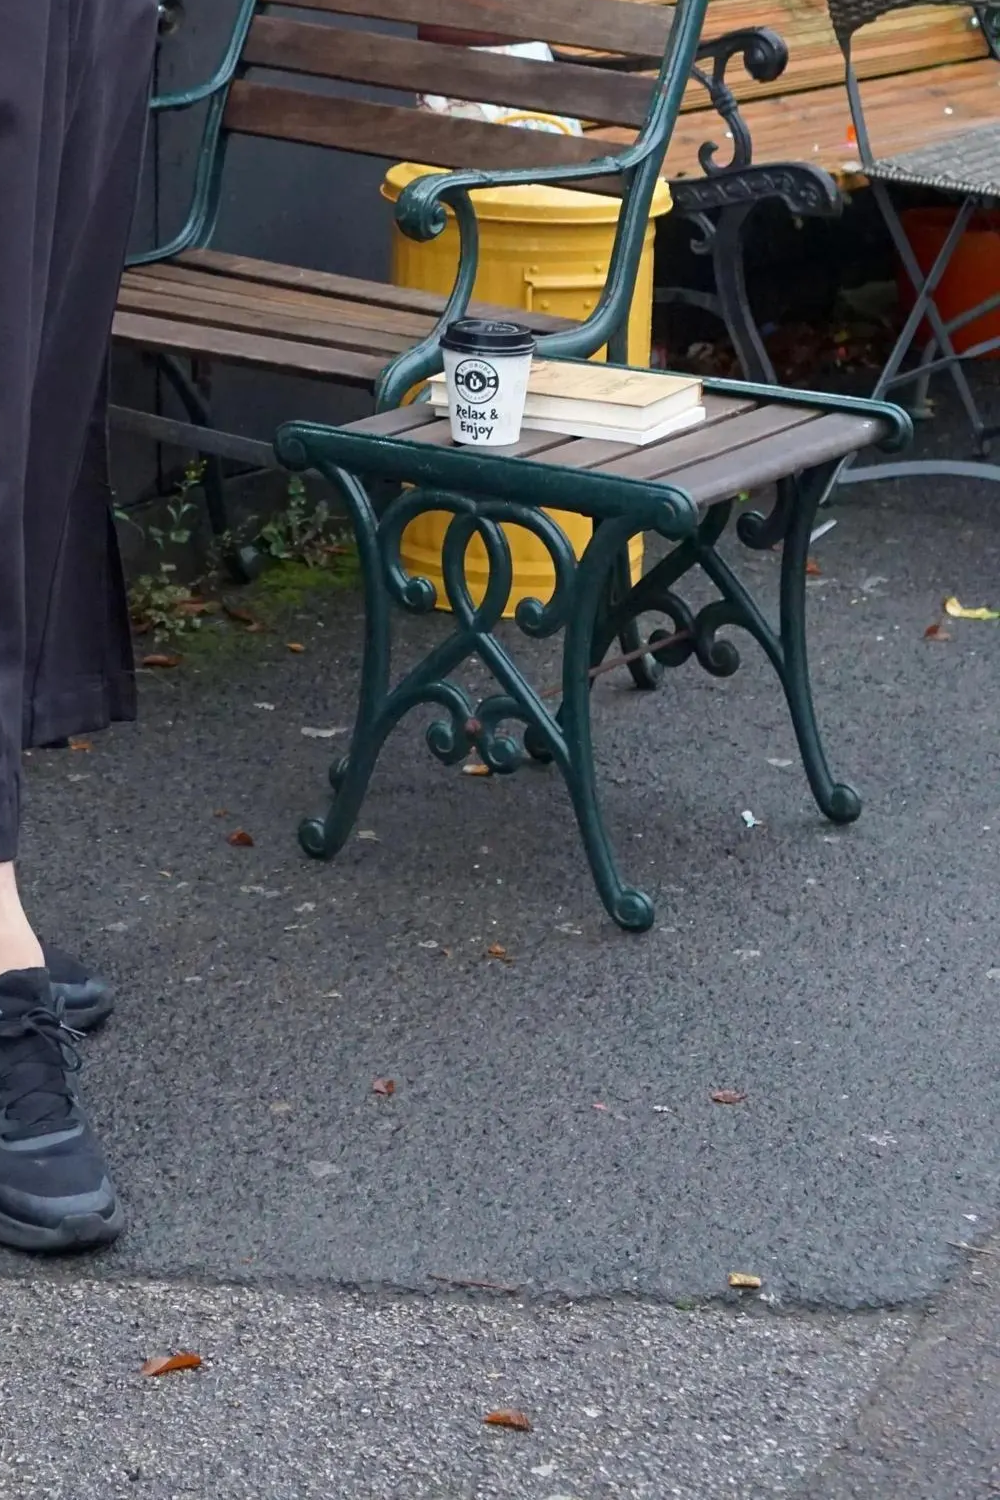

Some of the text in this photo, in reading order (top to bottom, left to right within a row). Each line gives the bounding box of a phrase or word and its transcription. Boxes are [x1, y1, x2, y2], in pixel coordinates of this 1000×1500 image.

[456, 404, 499, 420] Relax &
[460, 421, 494, 441] Enjoy
